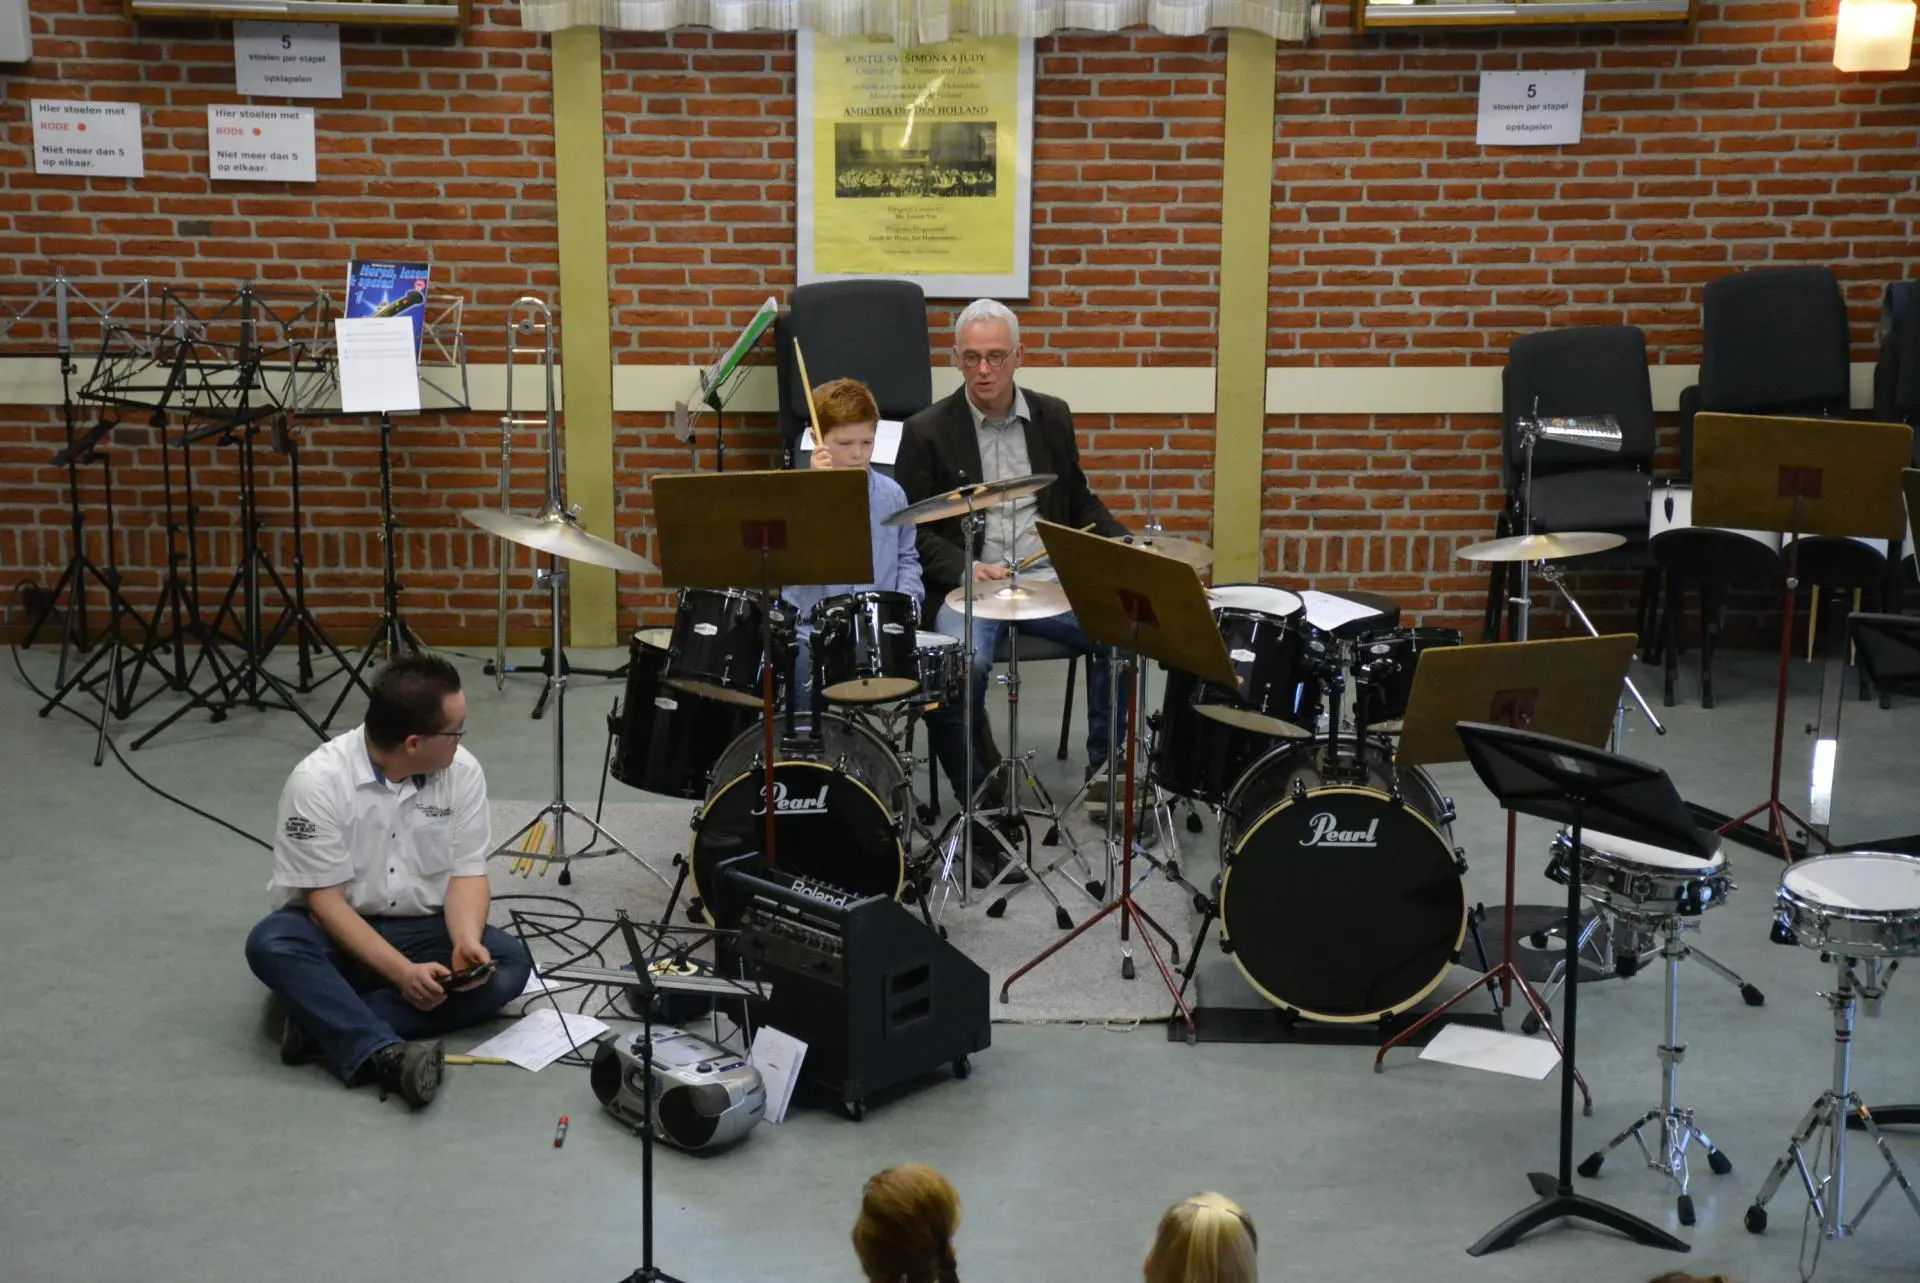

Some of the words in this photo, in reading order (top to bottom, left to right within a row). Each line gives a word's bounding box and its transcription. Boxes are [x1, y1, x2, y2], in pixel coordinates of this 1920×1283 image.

[281, 34, 292, 49] 5
[248, 53, 280, 61] stoelen
[282, 55, 297, 63] per
[298, 55, 326, 64] stapel
[950, 54, 957, 62] A
[959, 54, 986, 63] JUDY
[264, 75, 312, 84] opstapelen
[1527, 84, 1537, 98] 5
[39, 104, 61, 113] Hier
[63, 105, 102, 114] stoelen
[105, 107, 125, 115] met
[939, 105, 989, 116] HOLLAND
[1493, 103, 1524, 111] stoelen
[1542, 102, 1568, 111] stapel
[215, 109, 236, 118] Hier
[239, 110, 277, 119] stoelen
[40, 122, 70, 131] RODE
[216, 127, 244, 136] RODE
[1505, 123, 1552, 132] opstapelen
[42, 145, 63, 154] Niet
[66, 147, 93, 155] meer
[96, 148, 115, 156] dan
[217, 150, 238, 159] Niet
[241, 152, 267, 160] meer
[270, 151, 289, 160] dan
[42, 159, 56, 167] op
[59, 158, 95, 168] elkaar.
[217, 164, 230, 172] op
[233, 163, 268, 172] elkaar.
[751, 782, 829, 815] Pearl
[1299, 812, 1379, 847] Pearl
[791, 880, 846, 909] Roland
